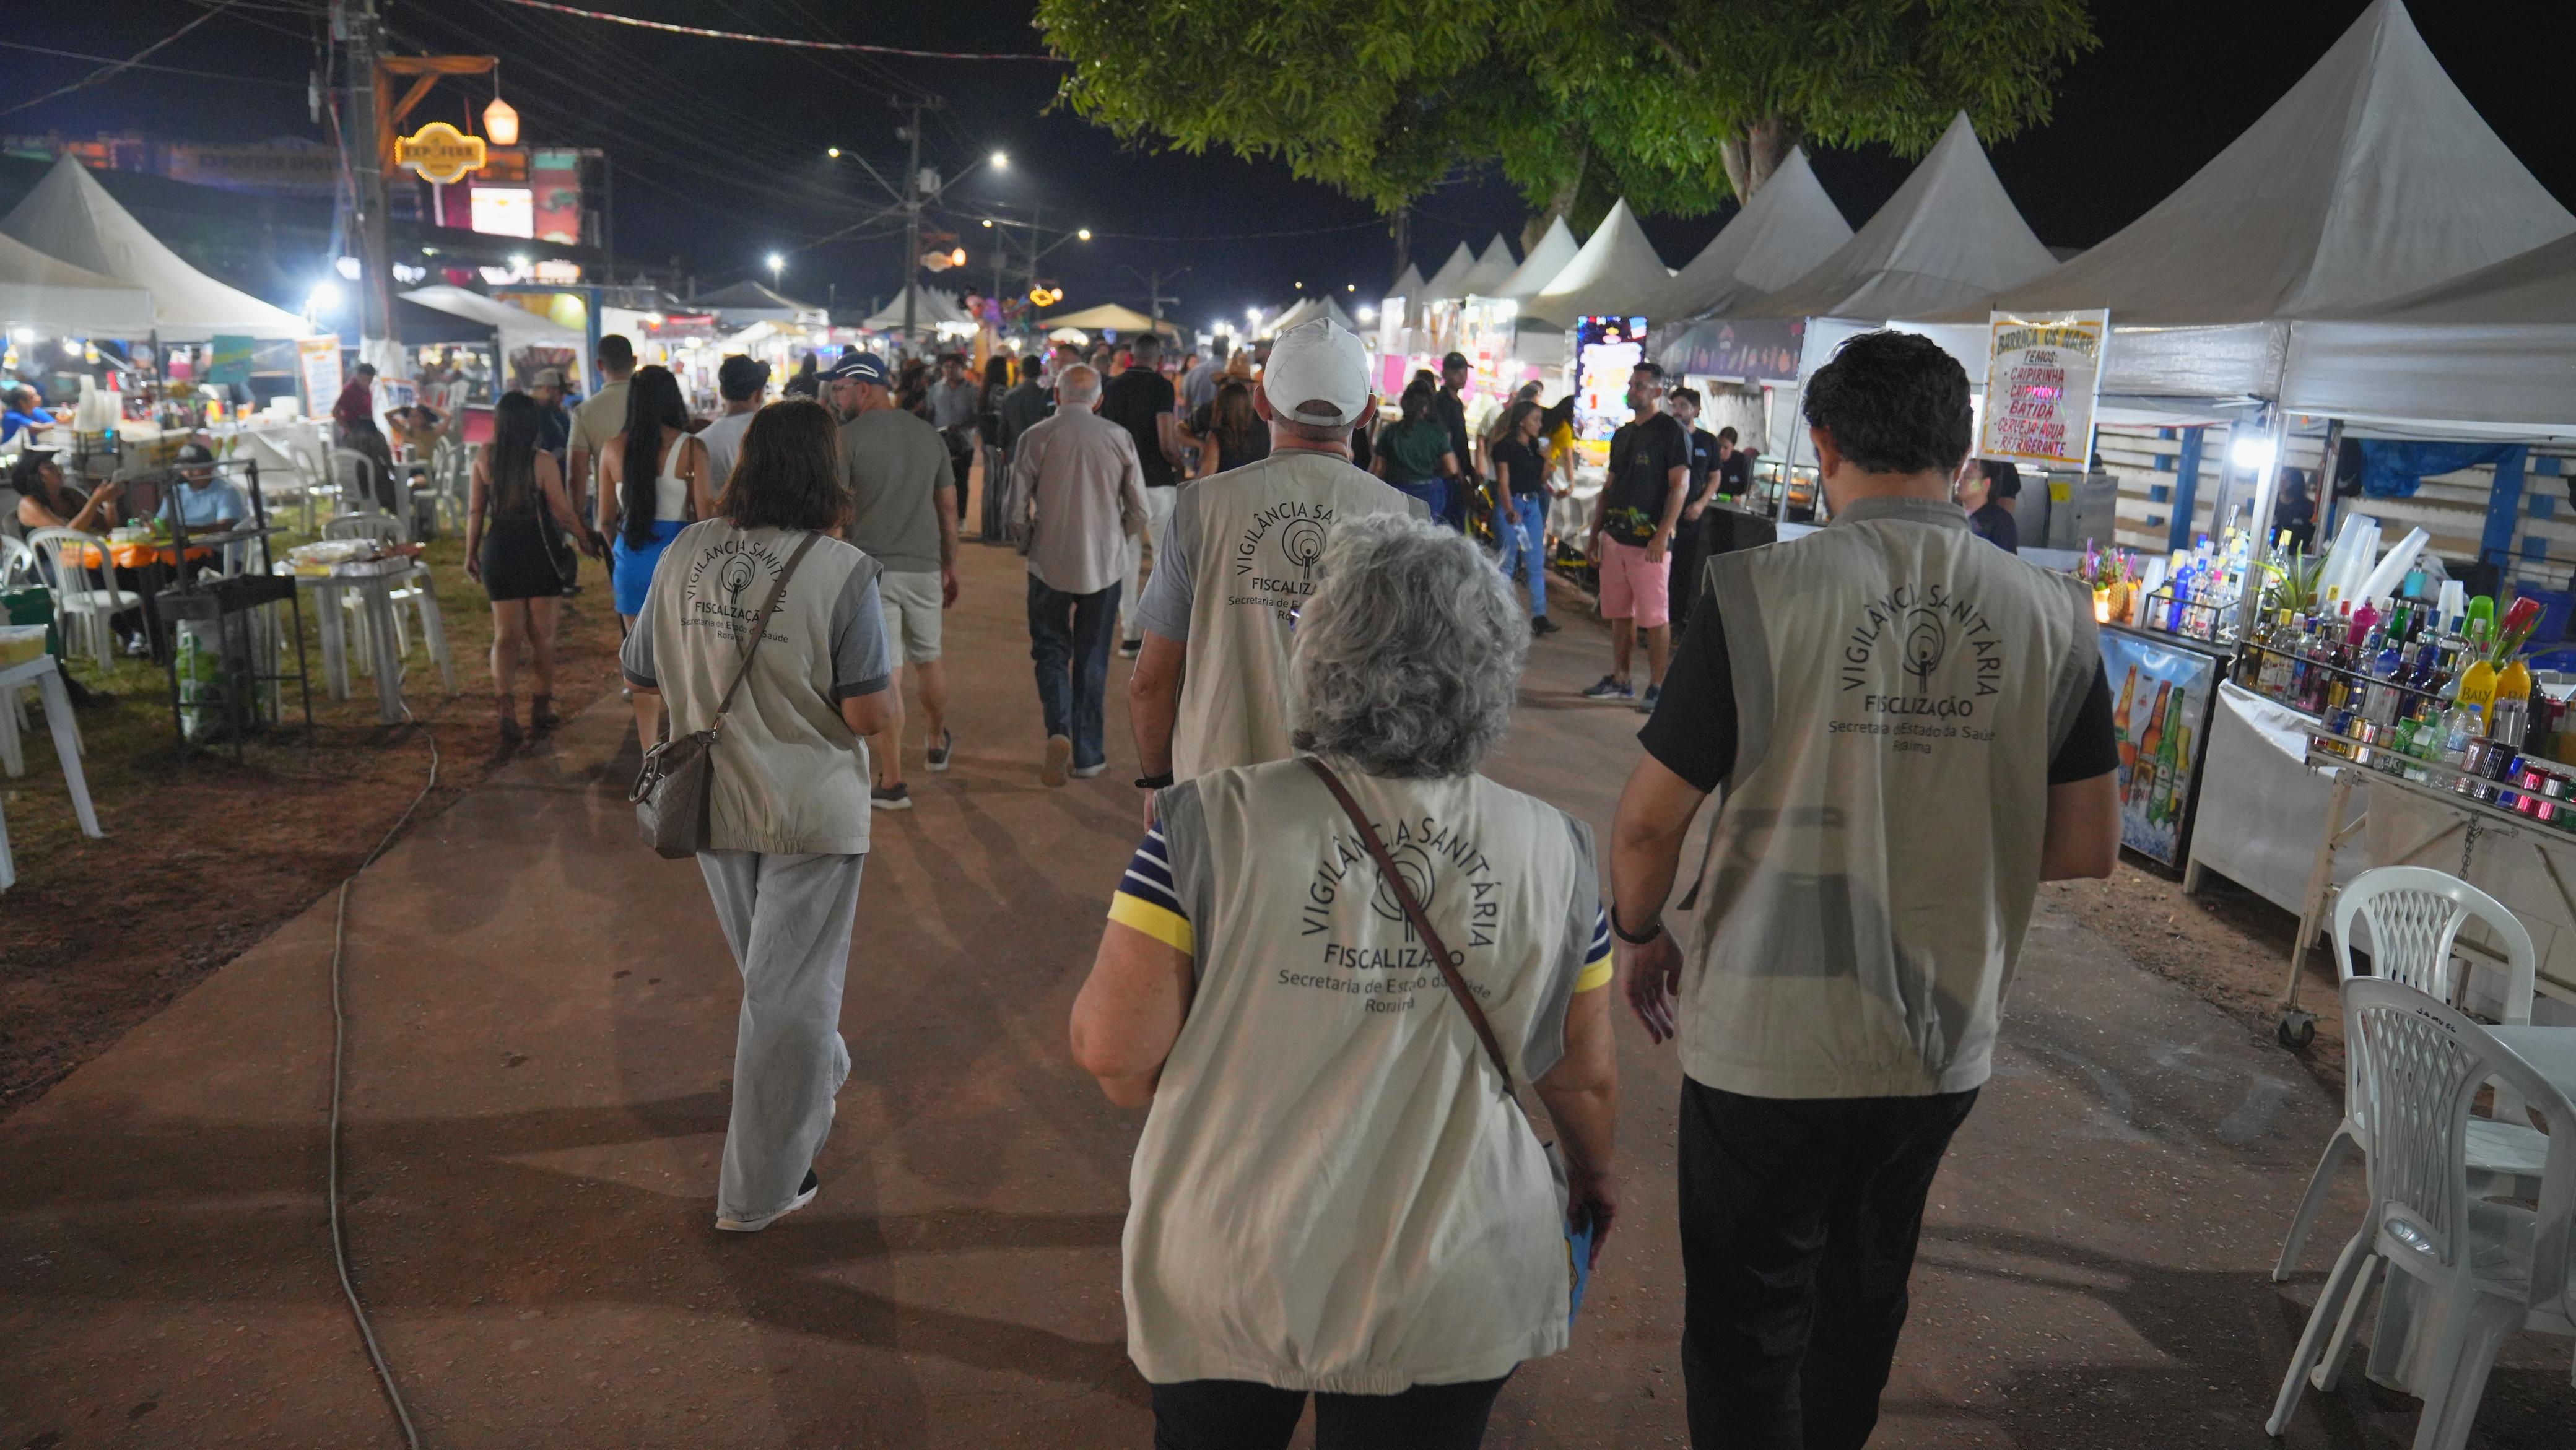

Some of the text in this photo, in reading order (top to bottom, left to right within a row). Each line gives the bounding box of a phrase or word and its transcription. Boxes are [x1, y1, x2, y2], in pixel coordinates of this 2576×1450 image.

[1997, 329, 2038, 356] BARRACA
[2011, 367, 2065, 383] CAIPIRINHA
[2009, 400, 2054, 419] BATIDA
[1999, 435, 2066, 457] REFRIGERANTE
[1237, 501, 1308, 576] VIGILÂNCIA
[687, 540, 790, 614] VIGILÂNCIA SANITRIA
[1228, 596, 1274, 607] Secretaria
[1277, 598, 1289, 608] de
[762, 630, 788, 643] Saúde
[1928, 584, 2002, 697] SANITÁRIA
[2462, 687, 2492, 703] BALY
[1417, 817, 1502, 948] SANITÁRIA
[1278, 969, 1360, 994] Secretaria
[1365, 978, 1382, 993] de
[2416, 1007, 2456, 1033] SAMUEL
